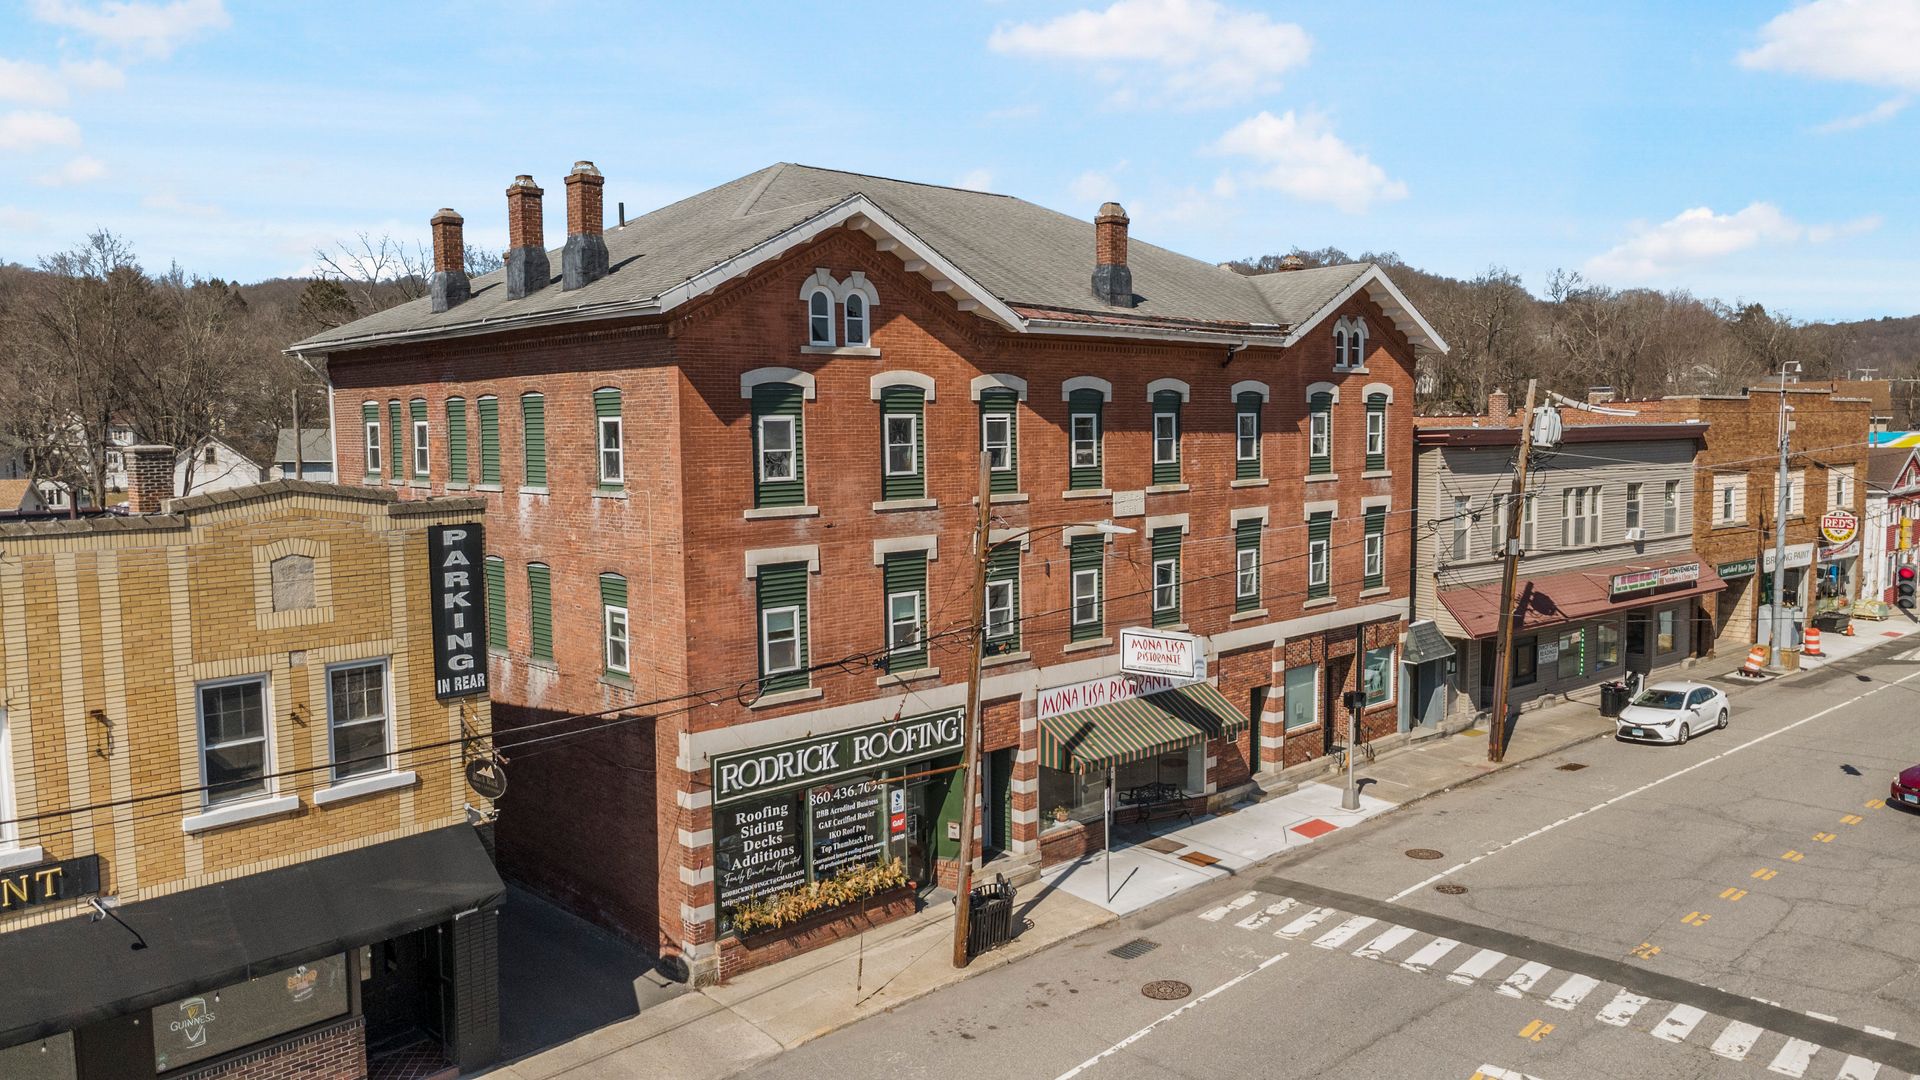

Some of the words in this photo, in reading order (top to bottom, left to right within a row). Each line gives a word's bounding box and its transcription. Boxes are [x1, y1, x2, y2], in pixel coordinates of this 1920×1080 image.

[1824, 518, 1854, 529] RED'S
[1793, 550, 1809, 560] PAINT
[1669, 564, 1698, 575] CONVENIENCE
[443, 530, 474, 671] PARKING
[1131, 639, 1162, 651] MONA
[438, 678, 450, 694] IN
[454, 673, 485, 691] REAR
[1042, 687, 1078, 716] MONA
[720, 741, 839, 793] RODRICK
[853, 716, 957, 764] ROOFING
[735, 804, 789, 825] Roofing
[816, 808, 829, 819] BBB
[856, 798, 879, 808] Business
[818, 820, 832, 829] GAF
[832, 813, 857, 827] Certified
[857, 810, 876, 821] Roofer
[892, 818, 904, 827] GAF
[741, 820, 784, 839] Siding
[842, 826, 855, 836] Roof
[856, 824, 866, 833] Pro
[743, 834, 783, 853] Decks
[821, 845, 833, 854] Top
[833, 836, 863, 850] Thumbtack
[731, 845, 795, 871] Additions
[1, 867, 62, 907] NT
[723, 869, 745, 887] Family
[170, 1012, 216, 1032] GUINNESS
